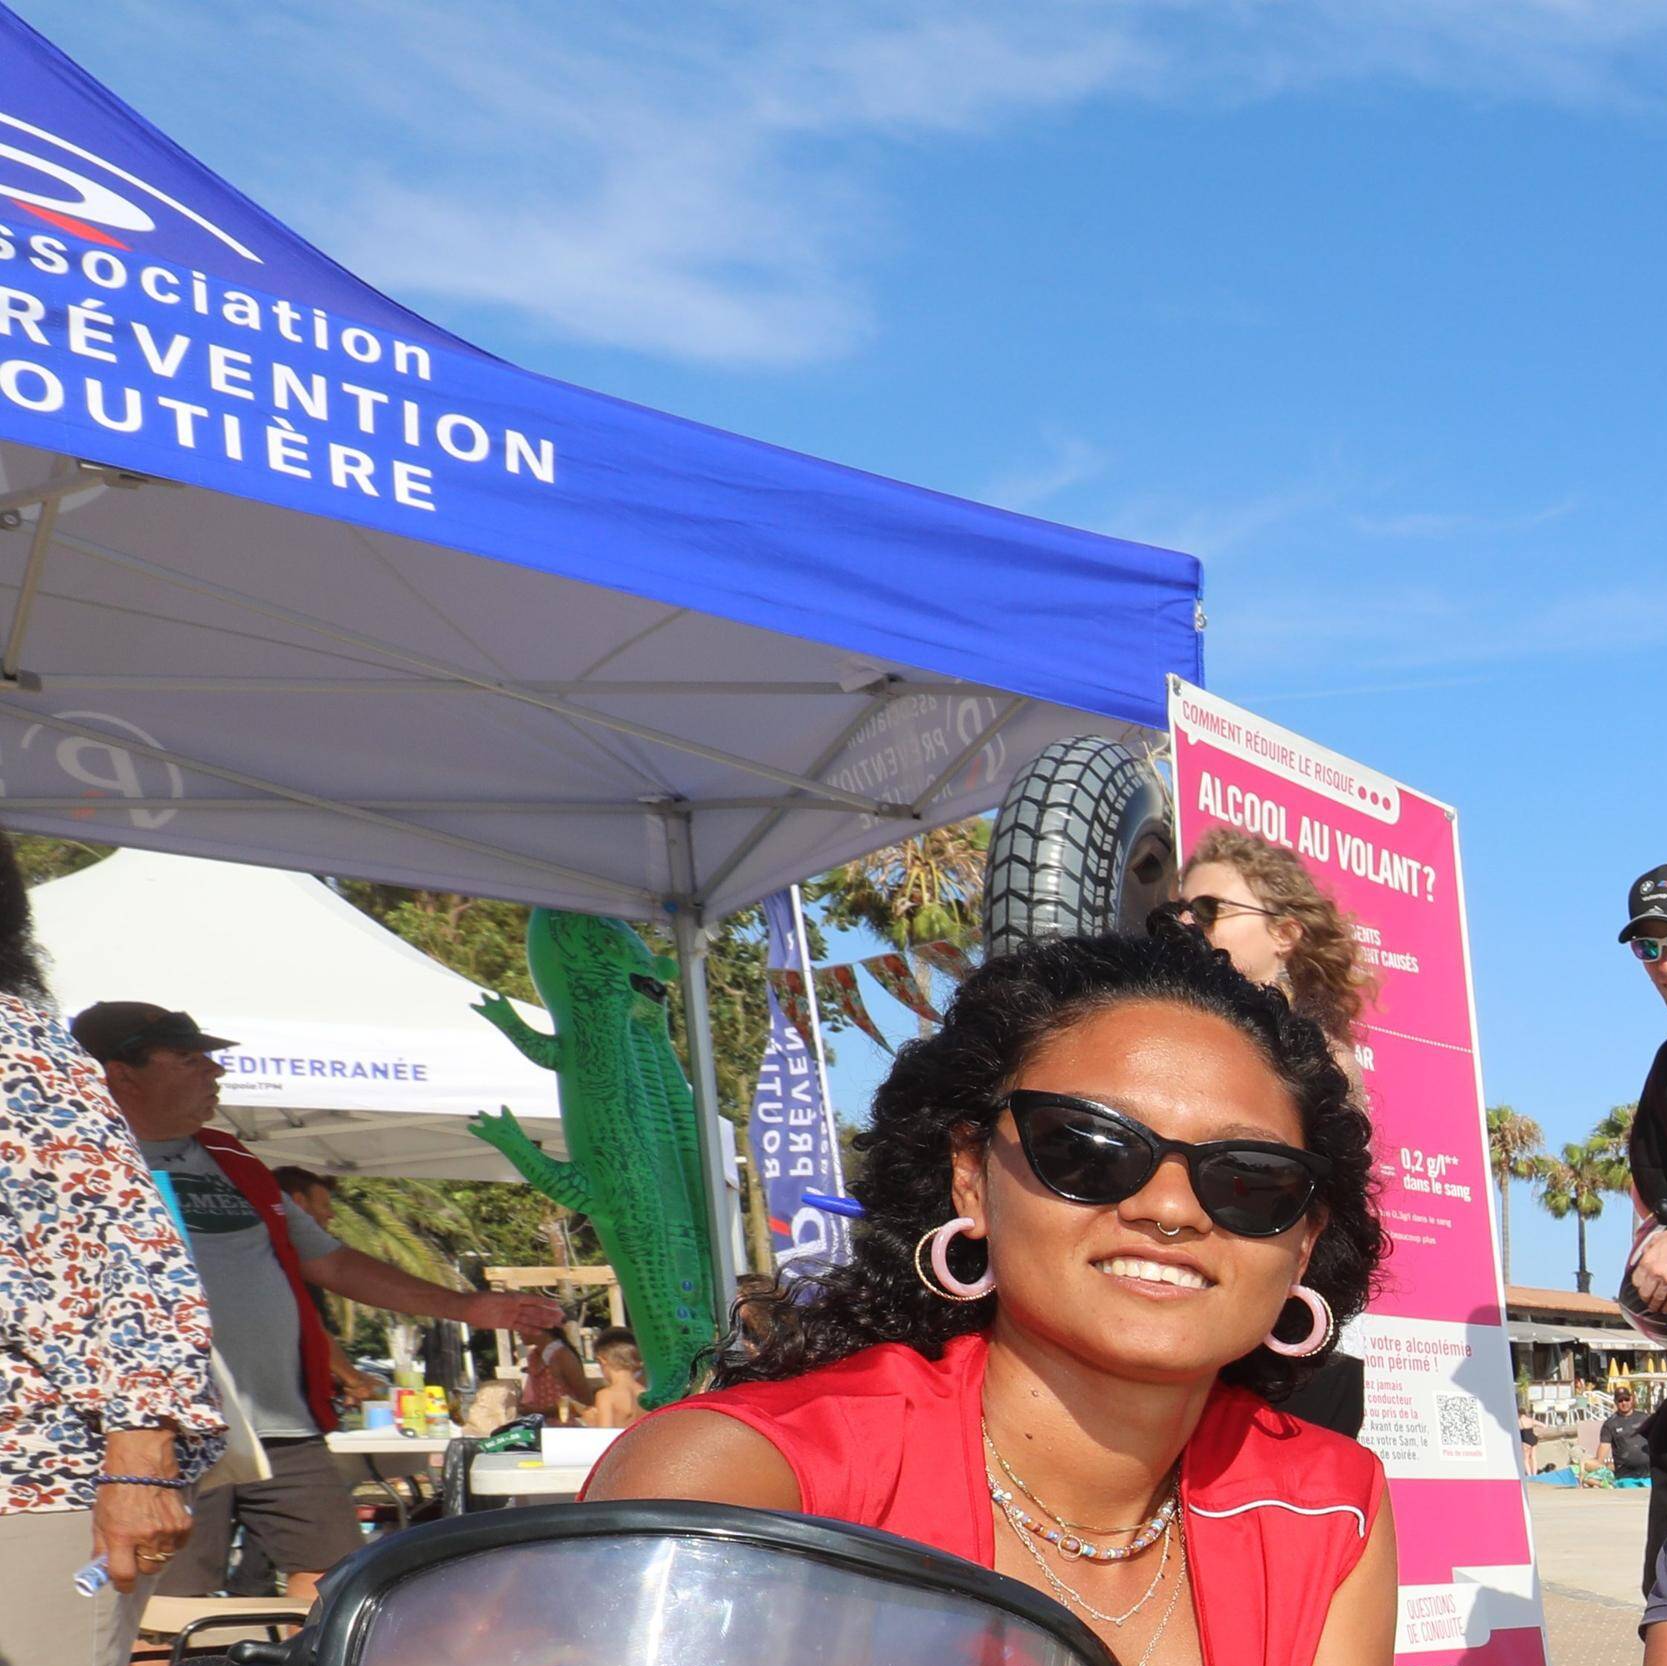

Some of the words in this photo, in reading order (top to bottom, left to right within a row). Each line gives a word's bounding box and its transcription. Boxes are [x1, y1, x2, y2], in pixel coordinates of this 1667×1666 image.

[0, 285, 555, 484] RÉVENTION
[0, 359, 437, 512] OUTIÈRE
[1182, 699, 1243, 746] COMMENT
[1245, 730, 1296, 771] RÉDUIRE
[1298, 755, 1312, 777] LE
[1315, 762, 1356, 797] RISQUE
[1198, 771, 1293, 848] ALCOOL
[1298, 815, 1331, 863] AU
[208, 1049, 429, 1082] ÉDITERRANÉE
[1401, 1147, 1424, 1173] 0,2
[1403, 1173, 1430, 1193] dans
[1431, 1177, 1442, 1195] le
[1445, 1181, 1472, 1203] sang
[1370, 1335, 1402, 1352] votre
[1405, 1337, 1473, 1357] alcoolémie
[1388, 1355, 1431, 1372] périmé
[1376, 1380, 1403, 1392] jamais
[1367, 1394, 1413, 1406] conducteur
[1370, 1421, 1392, 1432] Avant
[1394, 1422, 1404, 1433] de
[1381, 1409, 1398, 1420] pris
[1400, 1408, 1409, 1419] de
[1376, 1436, 1398, 1447] votre
[1406, 1593, 1457, 1620] QUESTIONS
[1406, 1623, 1421, 1645] DE
[1420, 1616, 1465, 1643] CONDUITE
